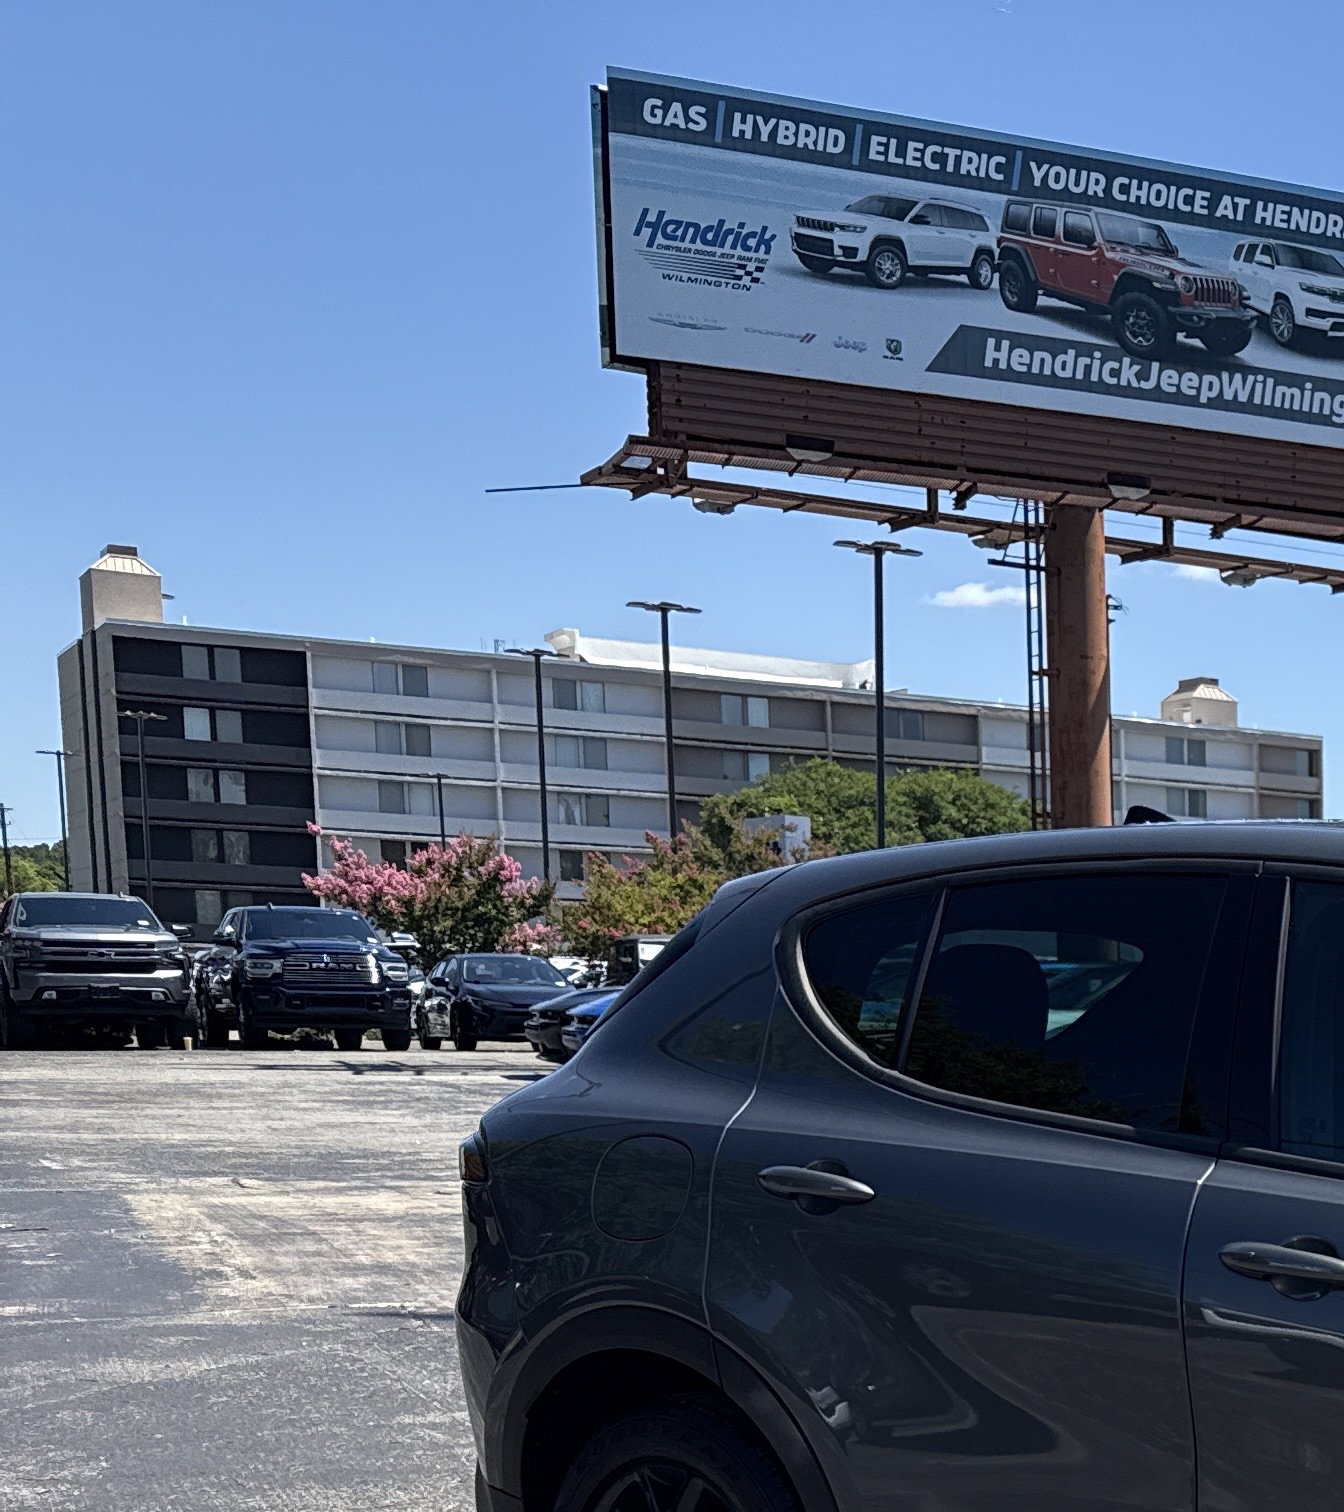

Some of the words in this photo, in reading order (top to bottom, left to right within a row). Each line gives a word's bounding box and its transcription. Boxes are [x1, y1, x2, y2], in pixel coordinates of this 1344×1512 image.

[643, 98, 707, 132] GAS
[731, 112, 846, 154] HYBRID
[868, 134, 1006, 181] ELECTRIC
[1029, 161, 1107, 198] YOUR
[1111, 176, 1211, 215] CHOICE
[1214, 195, 1250, 221] AT
[633, 207, 777, 255] Hendrick
[656, 243, 692, 254] CHRYSLER
[693, 248, 717, 258] DODGE
[718, 252, 735, 260] JEEP
[736, 255, 753, 263] RAM
[661, 273, 752, 291] WILMINGTON
[833, 336, 867, 353] Jeep
[311, 962, 354, 970] RAM
